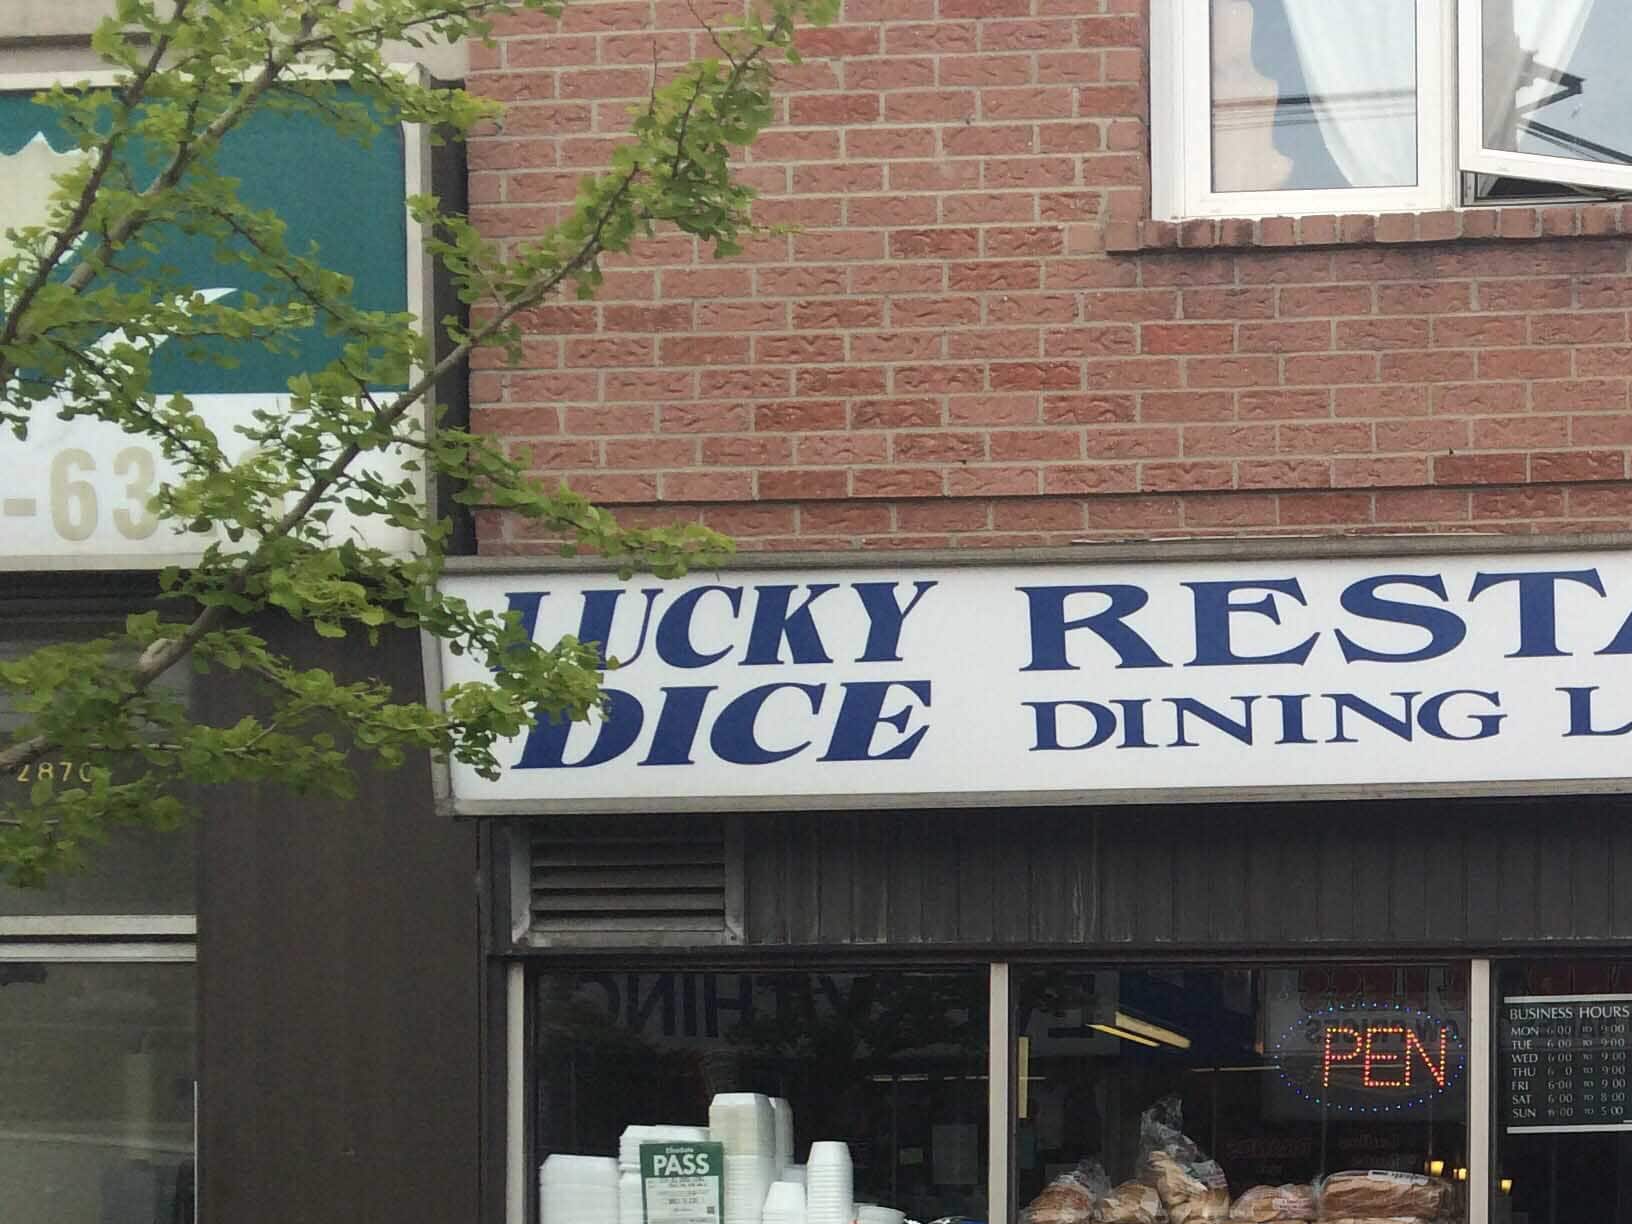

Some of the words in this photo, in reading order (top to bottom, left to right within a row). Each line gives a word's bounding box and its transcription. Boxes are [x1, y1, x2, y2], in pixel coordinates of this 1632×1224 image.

[490, 580, 939, 674] LUCKY
[511, 680, 932, 770] DICE
[1022, 690, 1507, 752] DINING
[1510, 1007, 1573, 1020] BUSINESS
[1579, 1005, 1630, 1019] HOURS
[1511, 1026, 1539, 1036] MON
[1512, 1040, 1533, 1050] TUE
[1511, 1053, 1538, 1063] WED
[1512, 1067, 1536, 1077] THU
[1511, 1080, 1529, 1091] FRI
[1512, 1093, 1532, 1105] SAT
[1513, 1107, 1536, 1118] SUN
[653, 1153, 710, 1176] PASS
